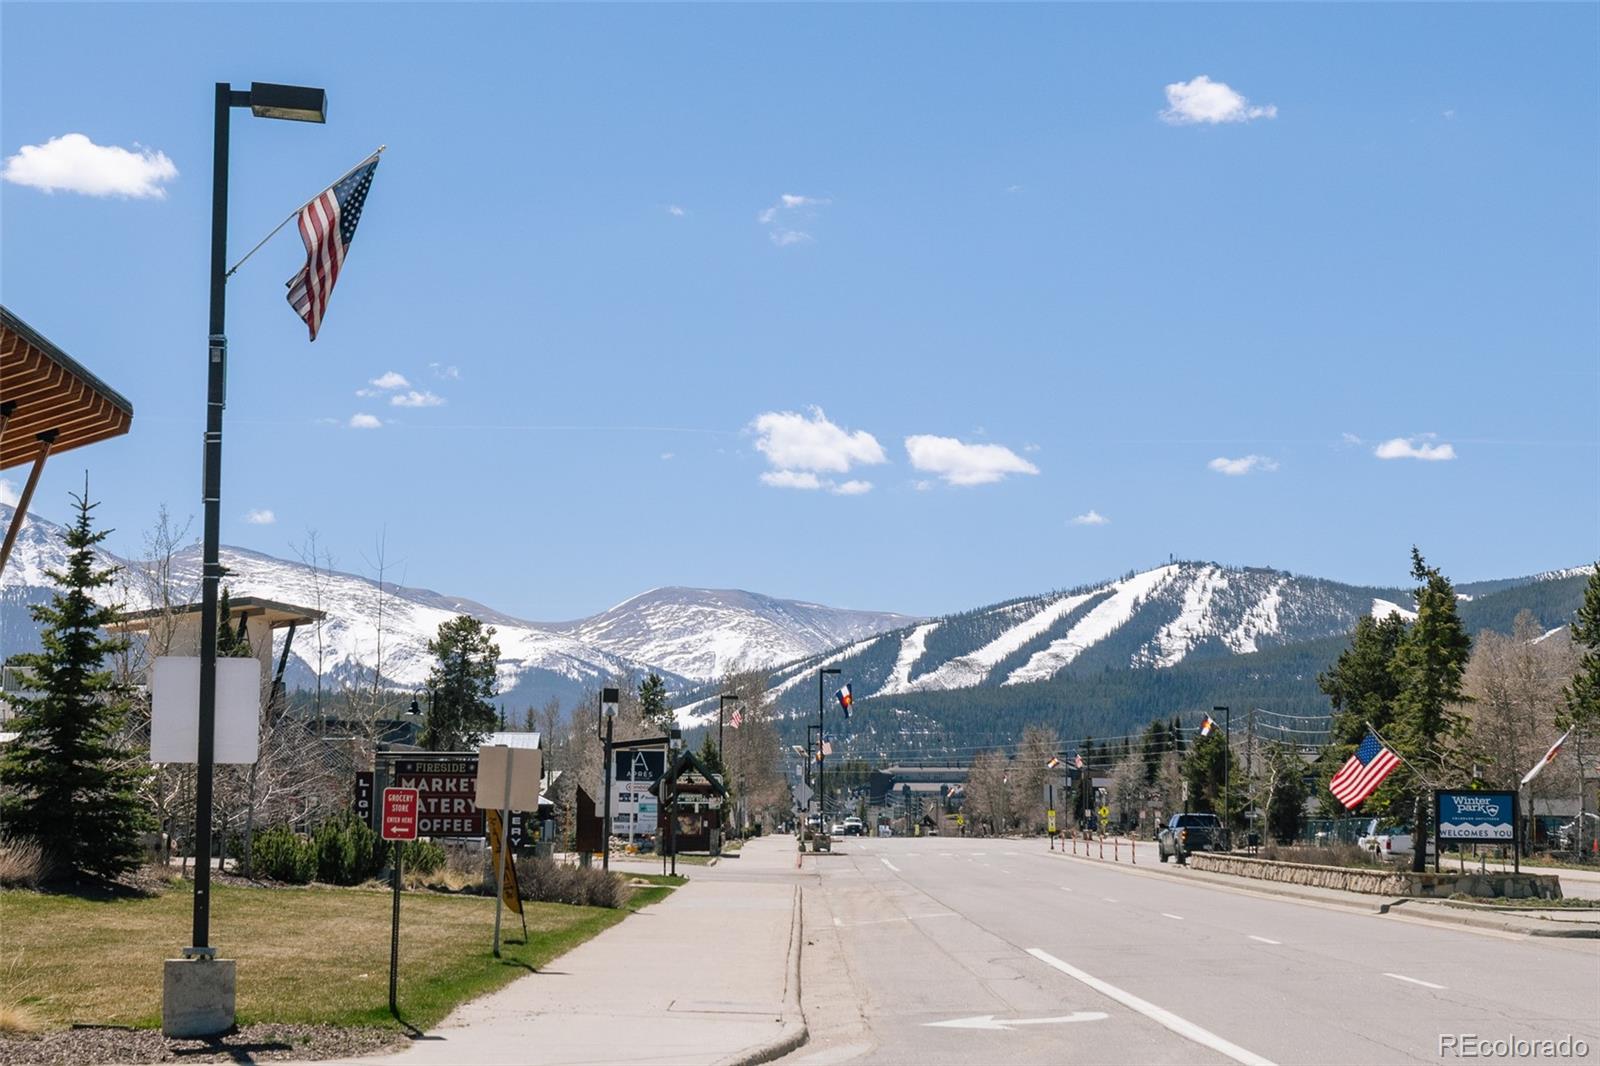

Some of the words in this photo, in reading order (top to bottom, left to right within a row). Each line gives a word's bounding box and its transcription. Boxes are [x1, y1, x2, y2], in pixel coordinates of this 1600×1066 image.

[415, 762, 466, 772] FIRESIDE
[387, 794, 414, 803] GROCERY
[1451, 796, 1491, 804] Winter
[391, 804, 409, 812] STORE
[418, 798, 477, 813] ATERY
[419, 818, 473, 832] OFFEE
[1440, 829, 1489, 837] WELCOMES
